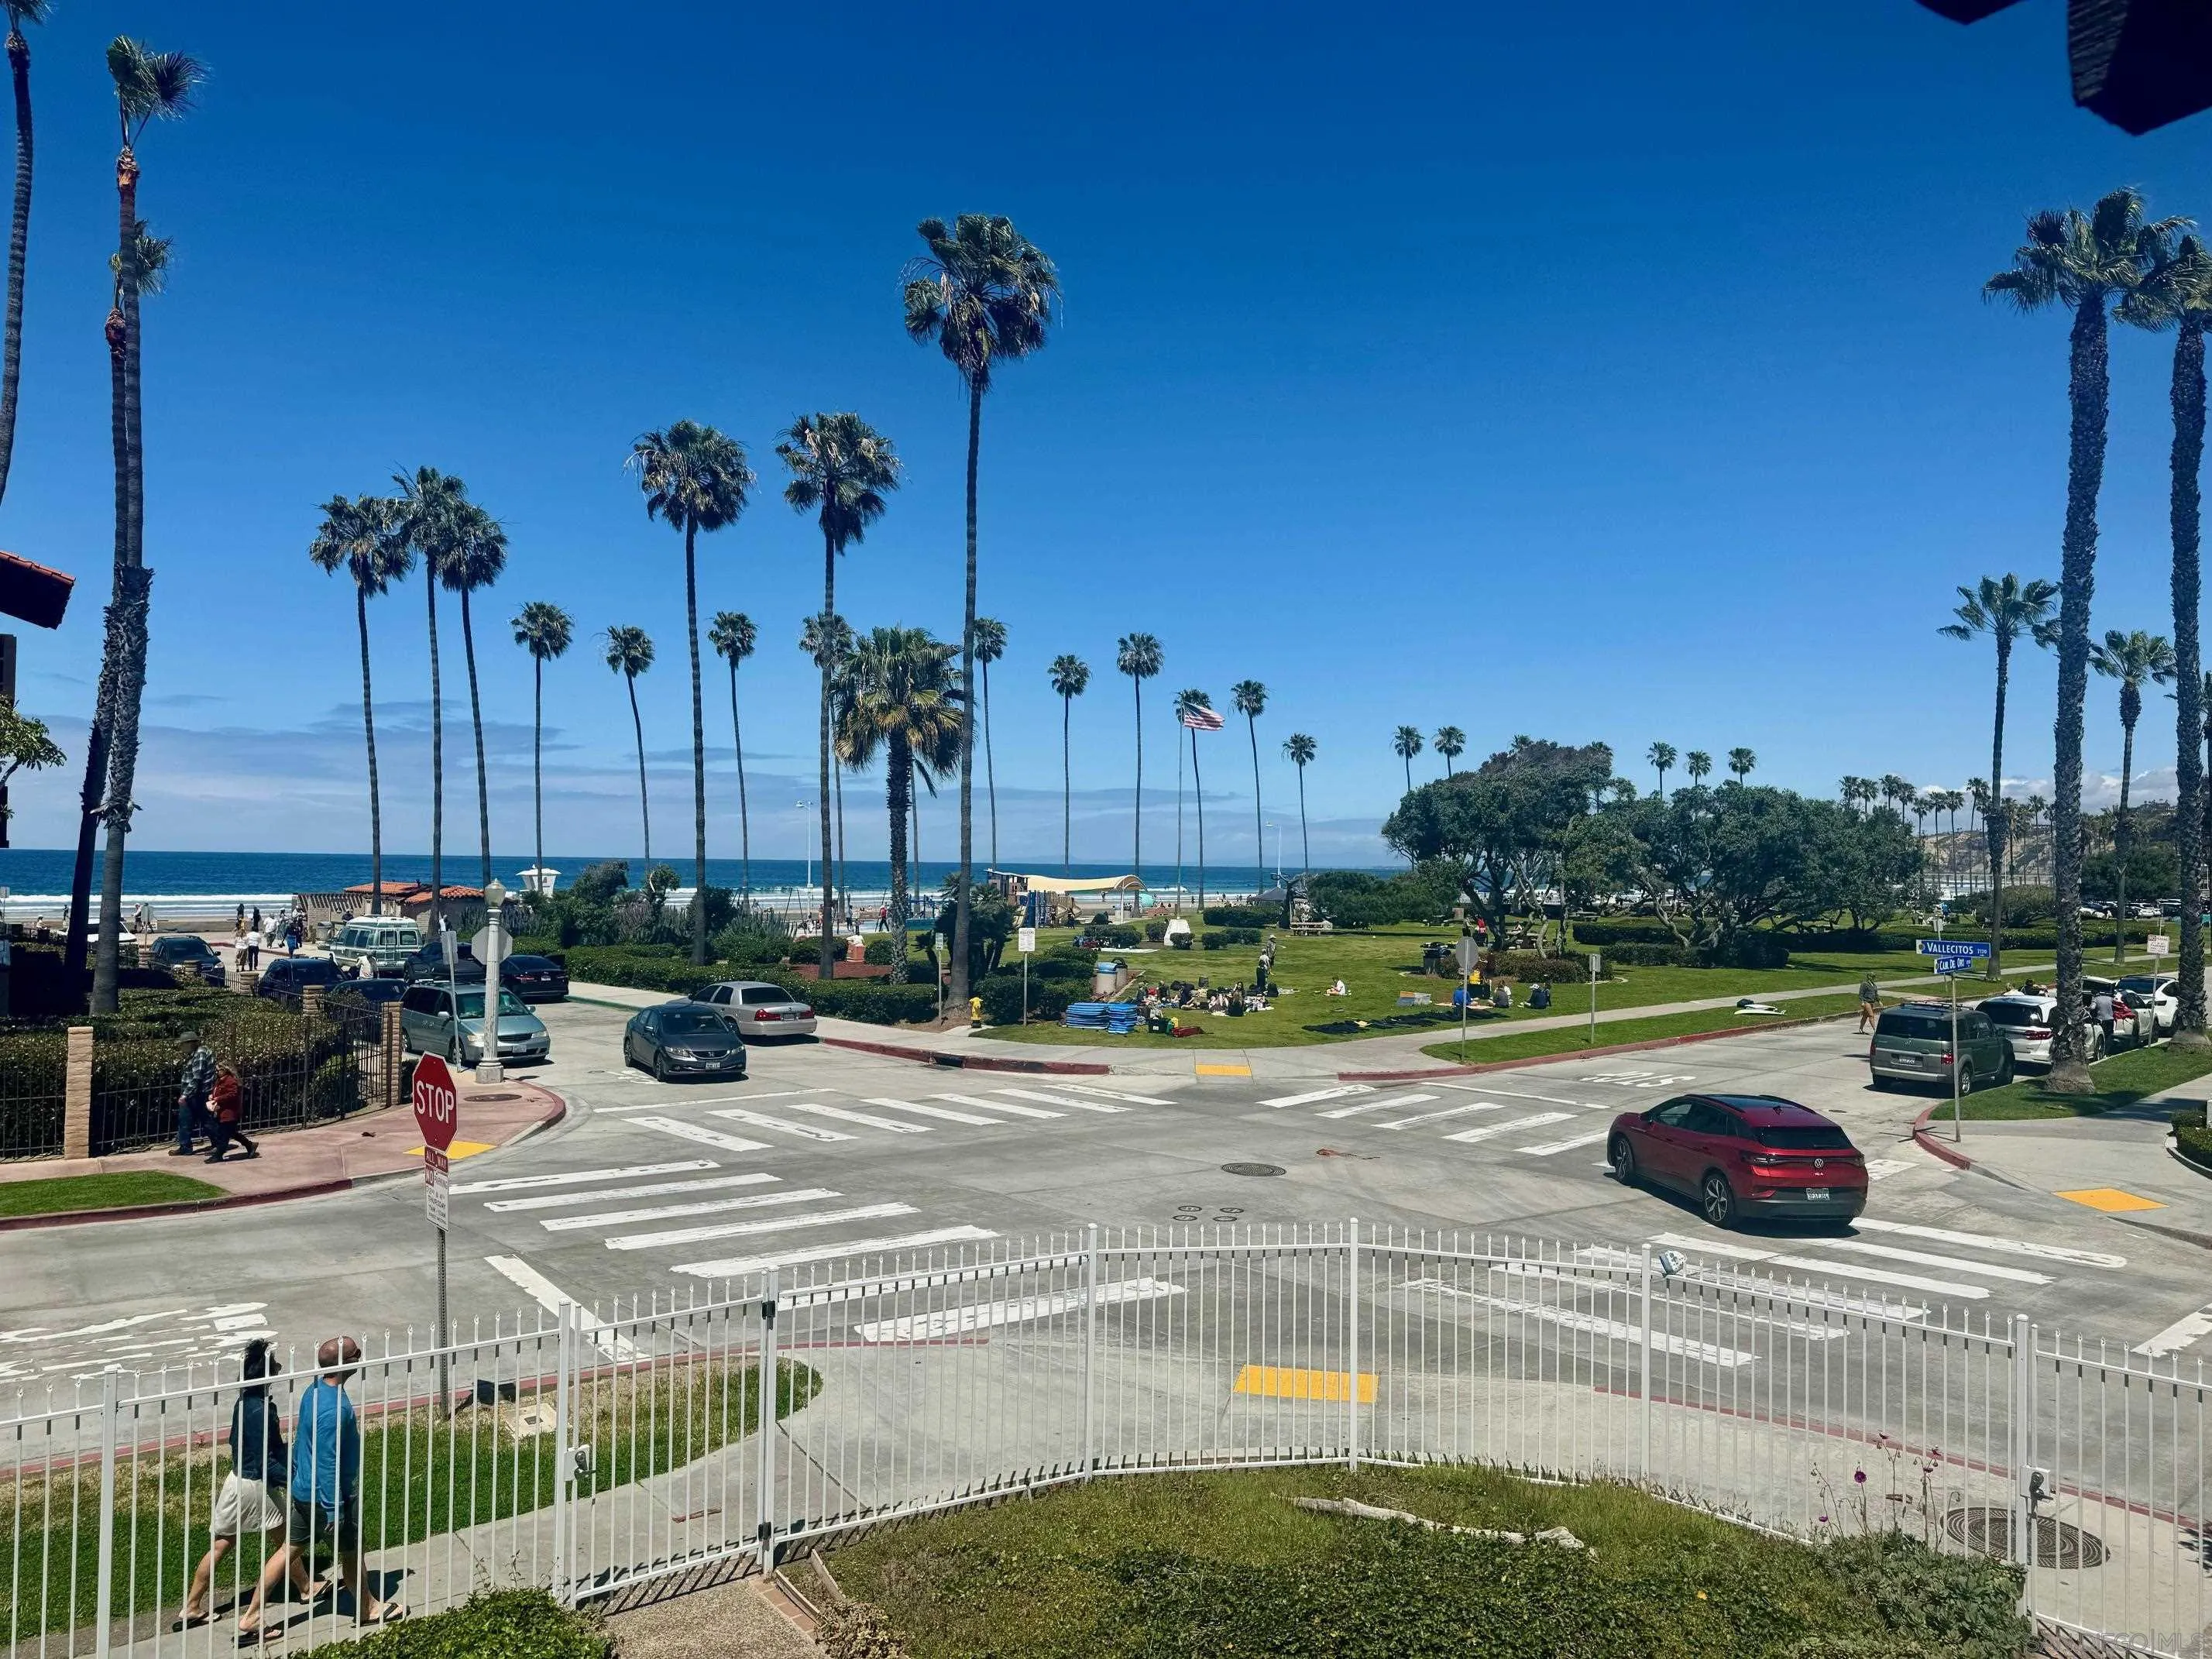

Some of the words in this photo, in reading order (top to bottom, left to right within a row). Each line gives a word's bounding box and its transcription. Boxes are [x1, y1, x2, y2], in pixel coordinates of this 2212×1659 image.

[1926, 942, 1973, 954] VALLECITOS
[416, 1080, 455, 1124] STOP
[426, 1150, 434, 1163] ALL
[437, 1155, 447, 1170] WAY
[426, 1166, 434, 1184] NO
